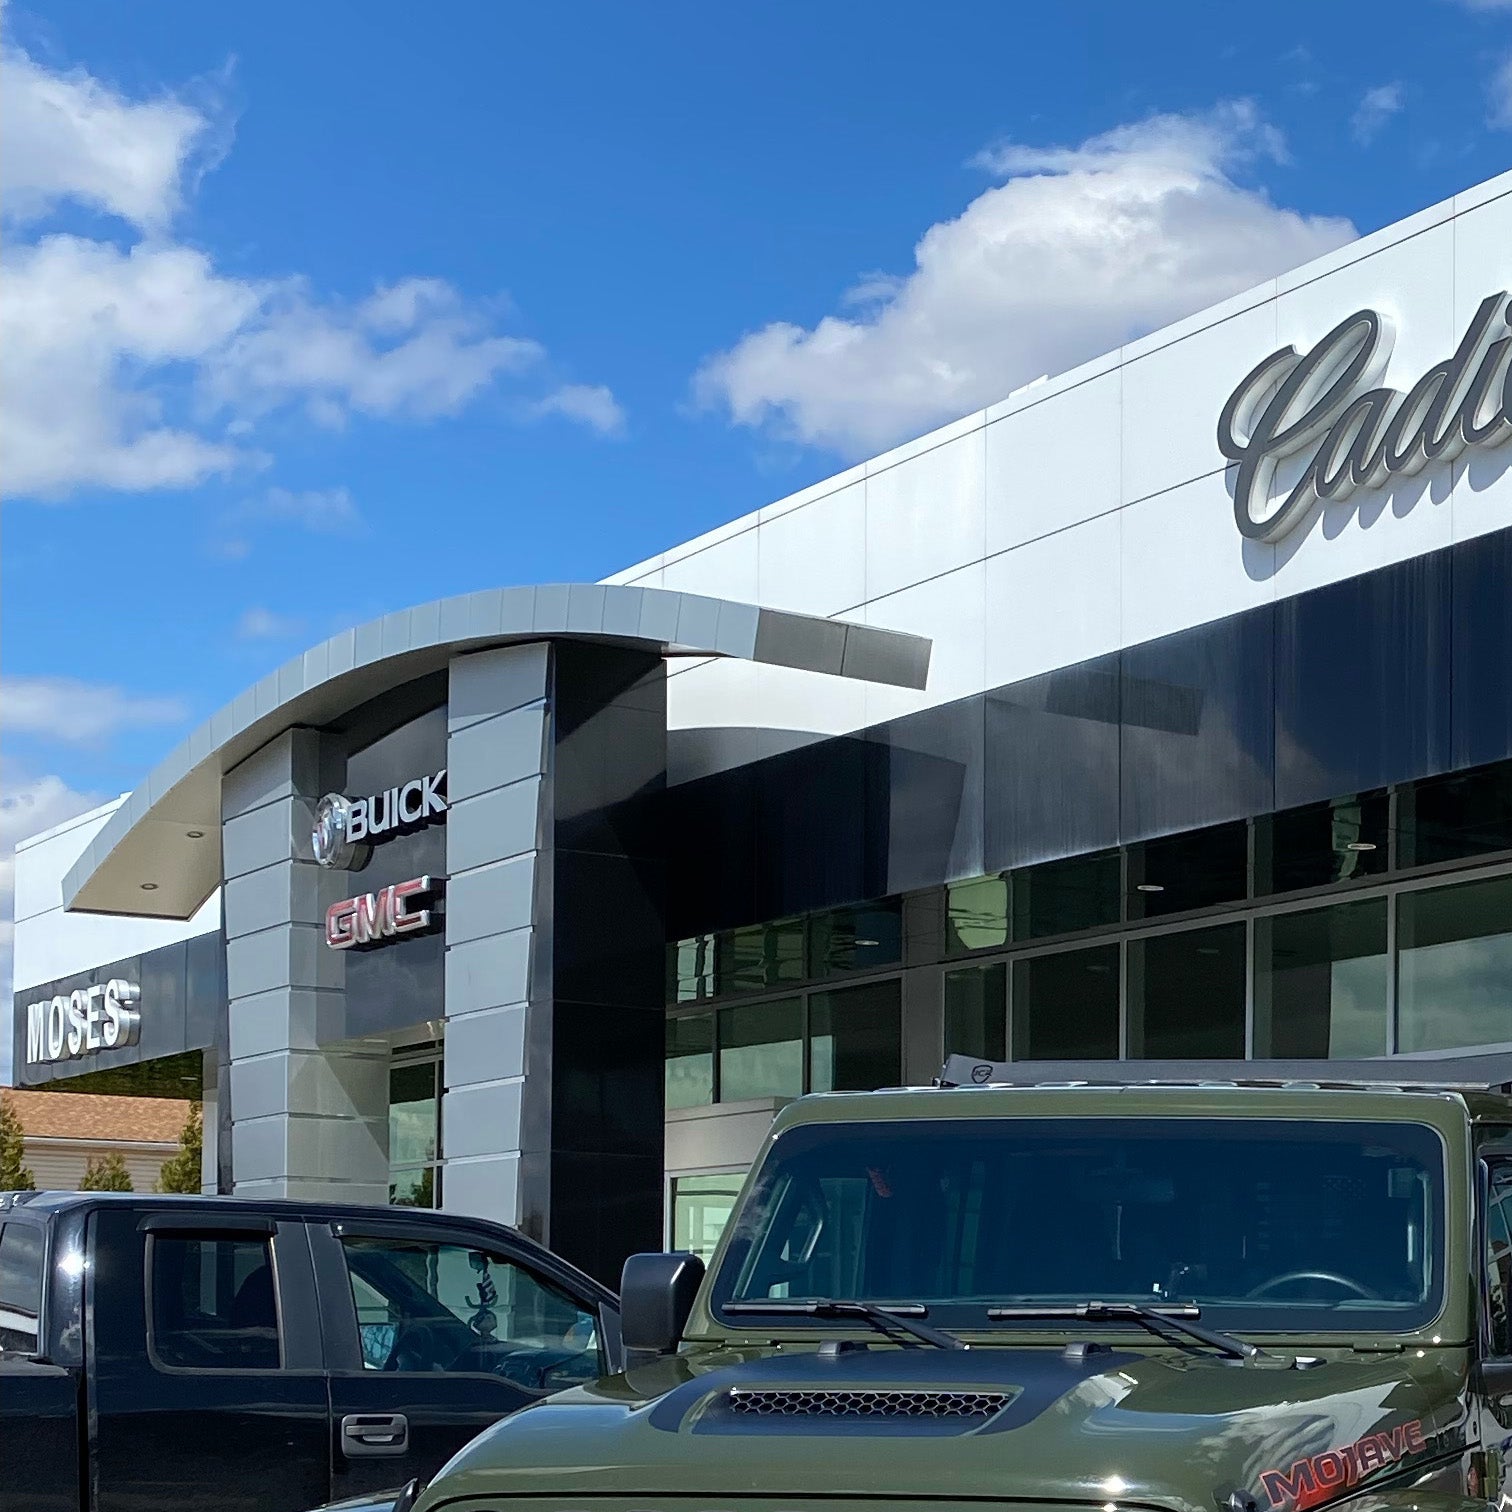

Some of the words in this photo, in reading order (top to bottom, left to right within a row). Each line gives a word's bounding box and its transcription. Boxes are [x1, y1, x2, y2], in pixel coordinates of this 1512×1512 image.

[346, 769, 448, 843] BUICK
[326, 874, 430, 950] GMC
[26, 978, 132, 1064] MOSES
[1260, 1419, 1427, 1507] MOJAVE
